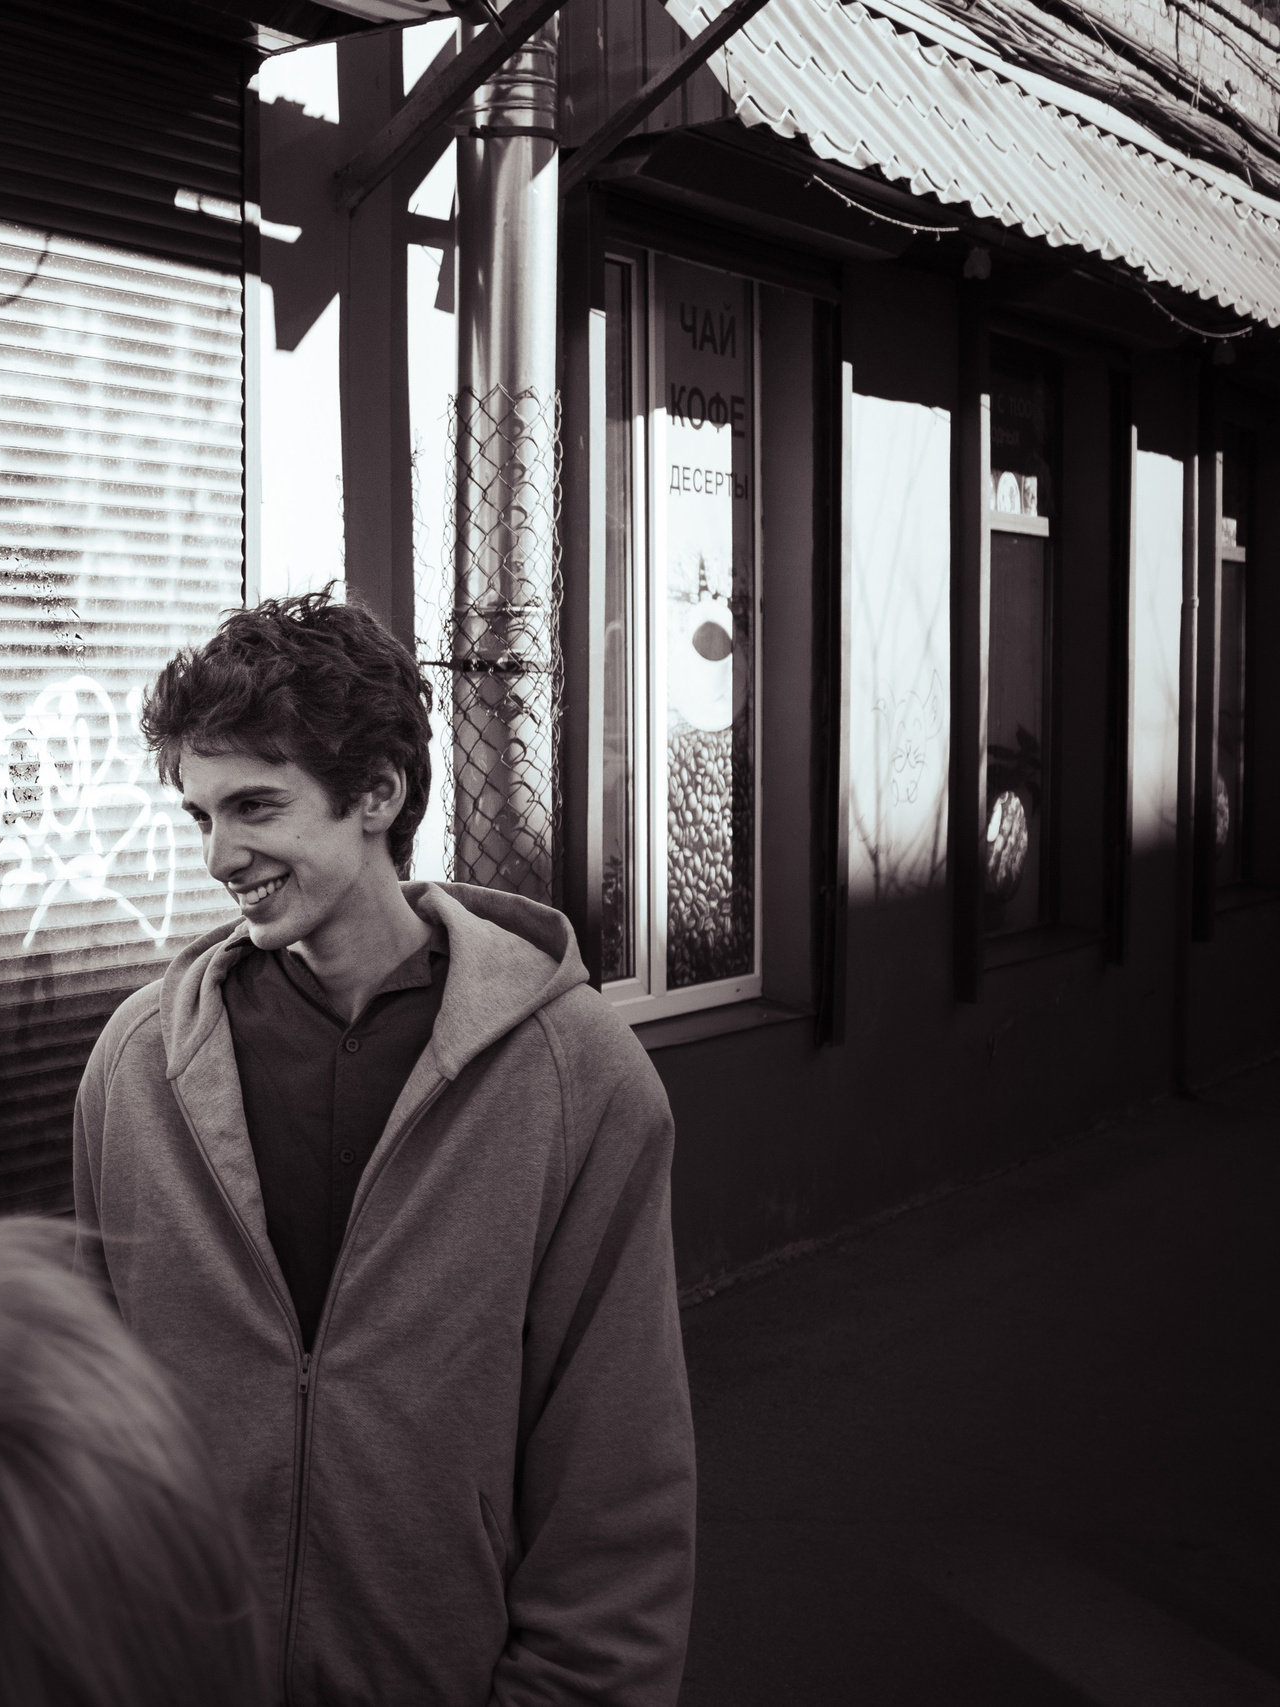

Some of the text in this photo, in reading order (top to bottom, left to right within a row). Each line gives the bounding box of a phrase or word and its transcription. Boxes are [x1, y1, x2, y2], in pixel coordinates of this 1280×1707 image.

[679, 302, 737, 359] ЧАЙ
[671, 383, 746, 439] КОФЕ
[669, 464, 749, 501] ДЕСЕРТЫ
